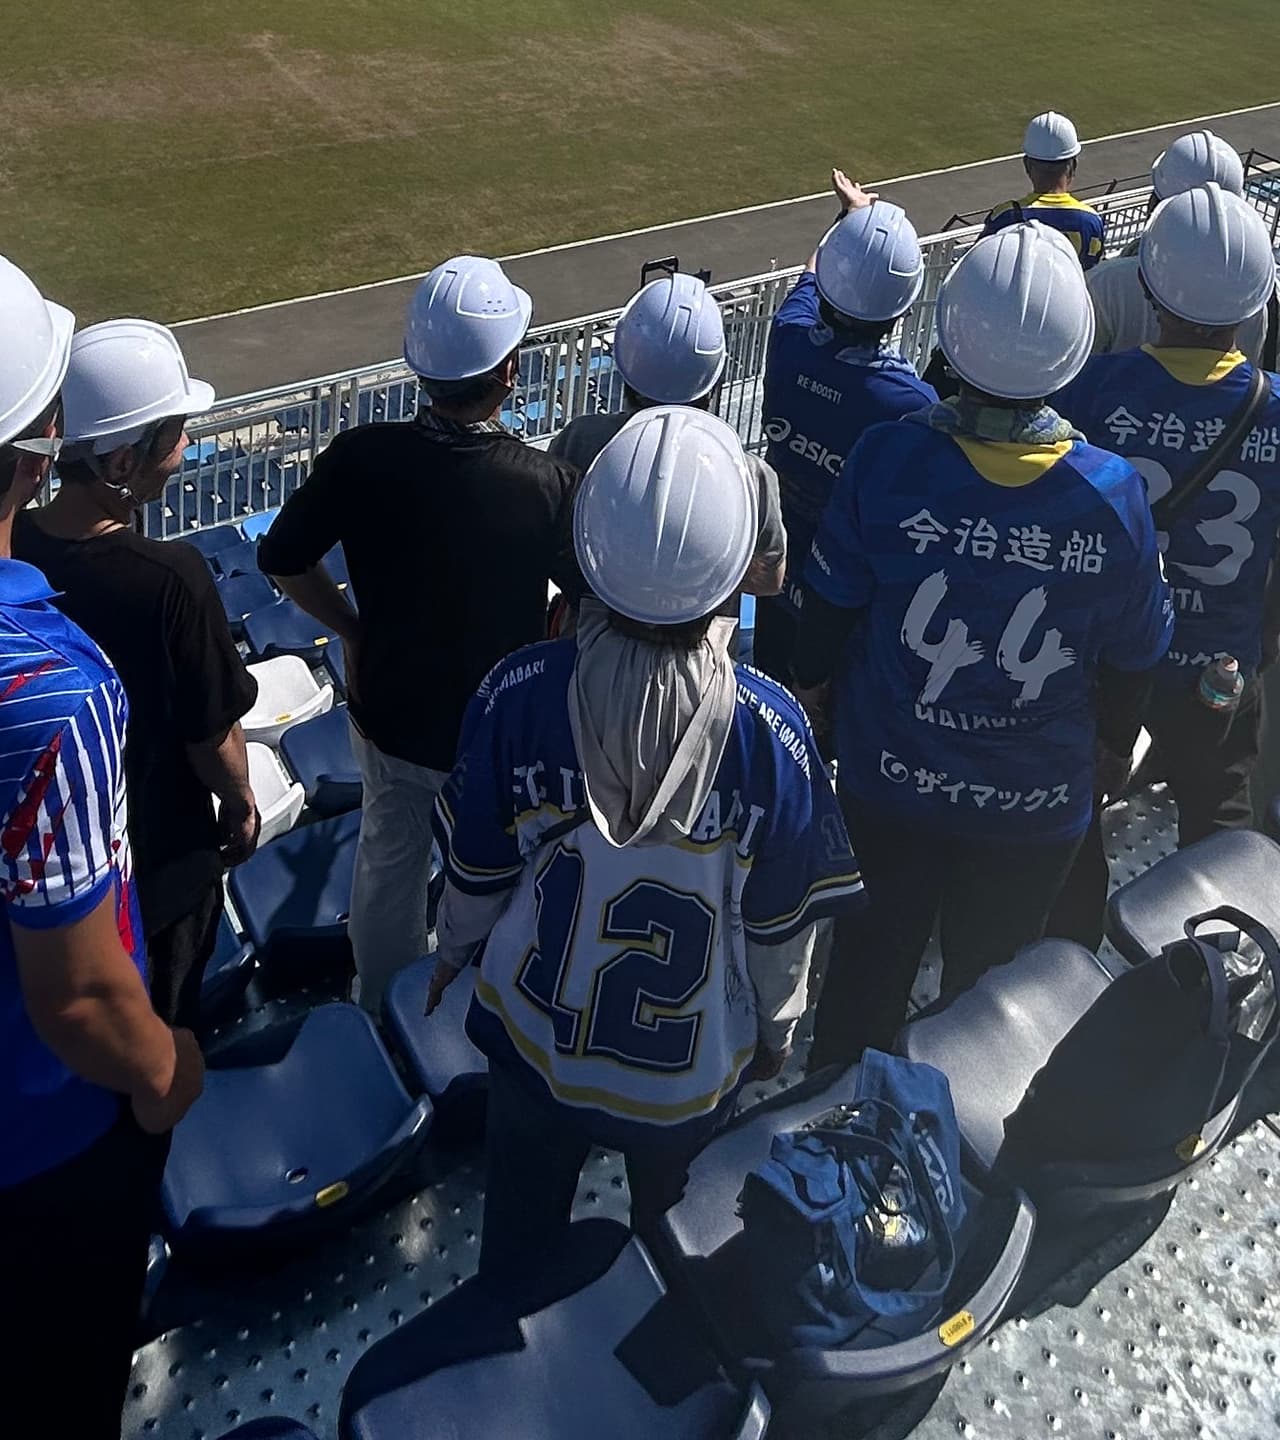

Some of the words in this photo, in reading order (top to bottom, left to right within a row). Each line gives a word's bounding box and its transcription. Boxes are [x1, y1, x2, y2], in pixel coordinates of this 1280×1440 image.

[898, 508, 1108, 575] 今治造船
[900, 567, 1078, 710] 44
[912, 767, 1070, 812] ザイマックス
[516, 843, 716, 1074] 12
